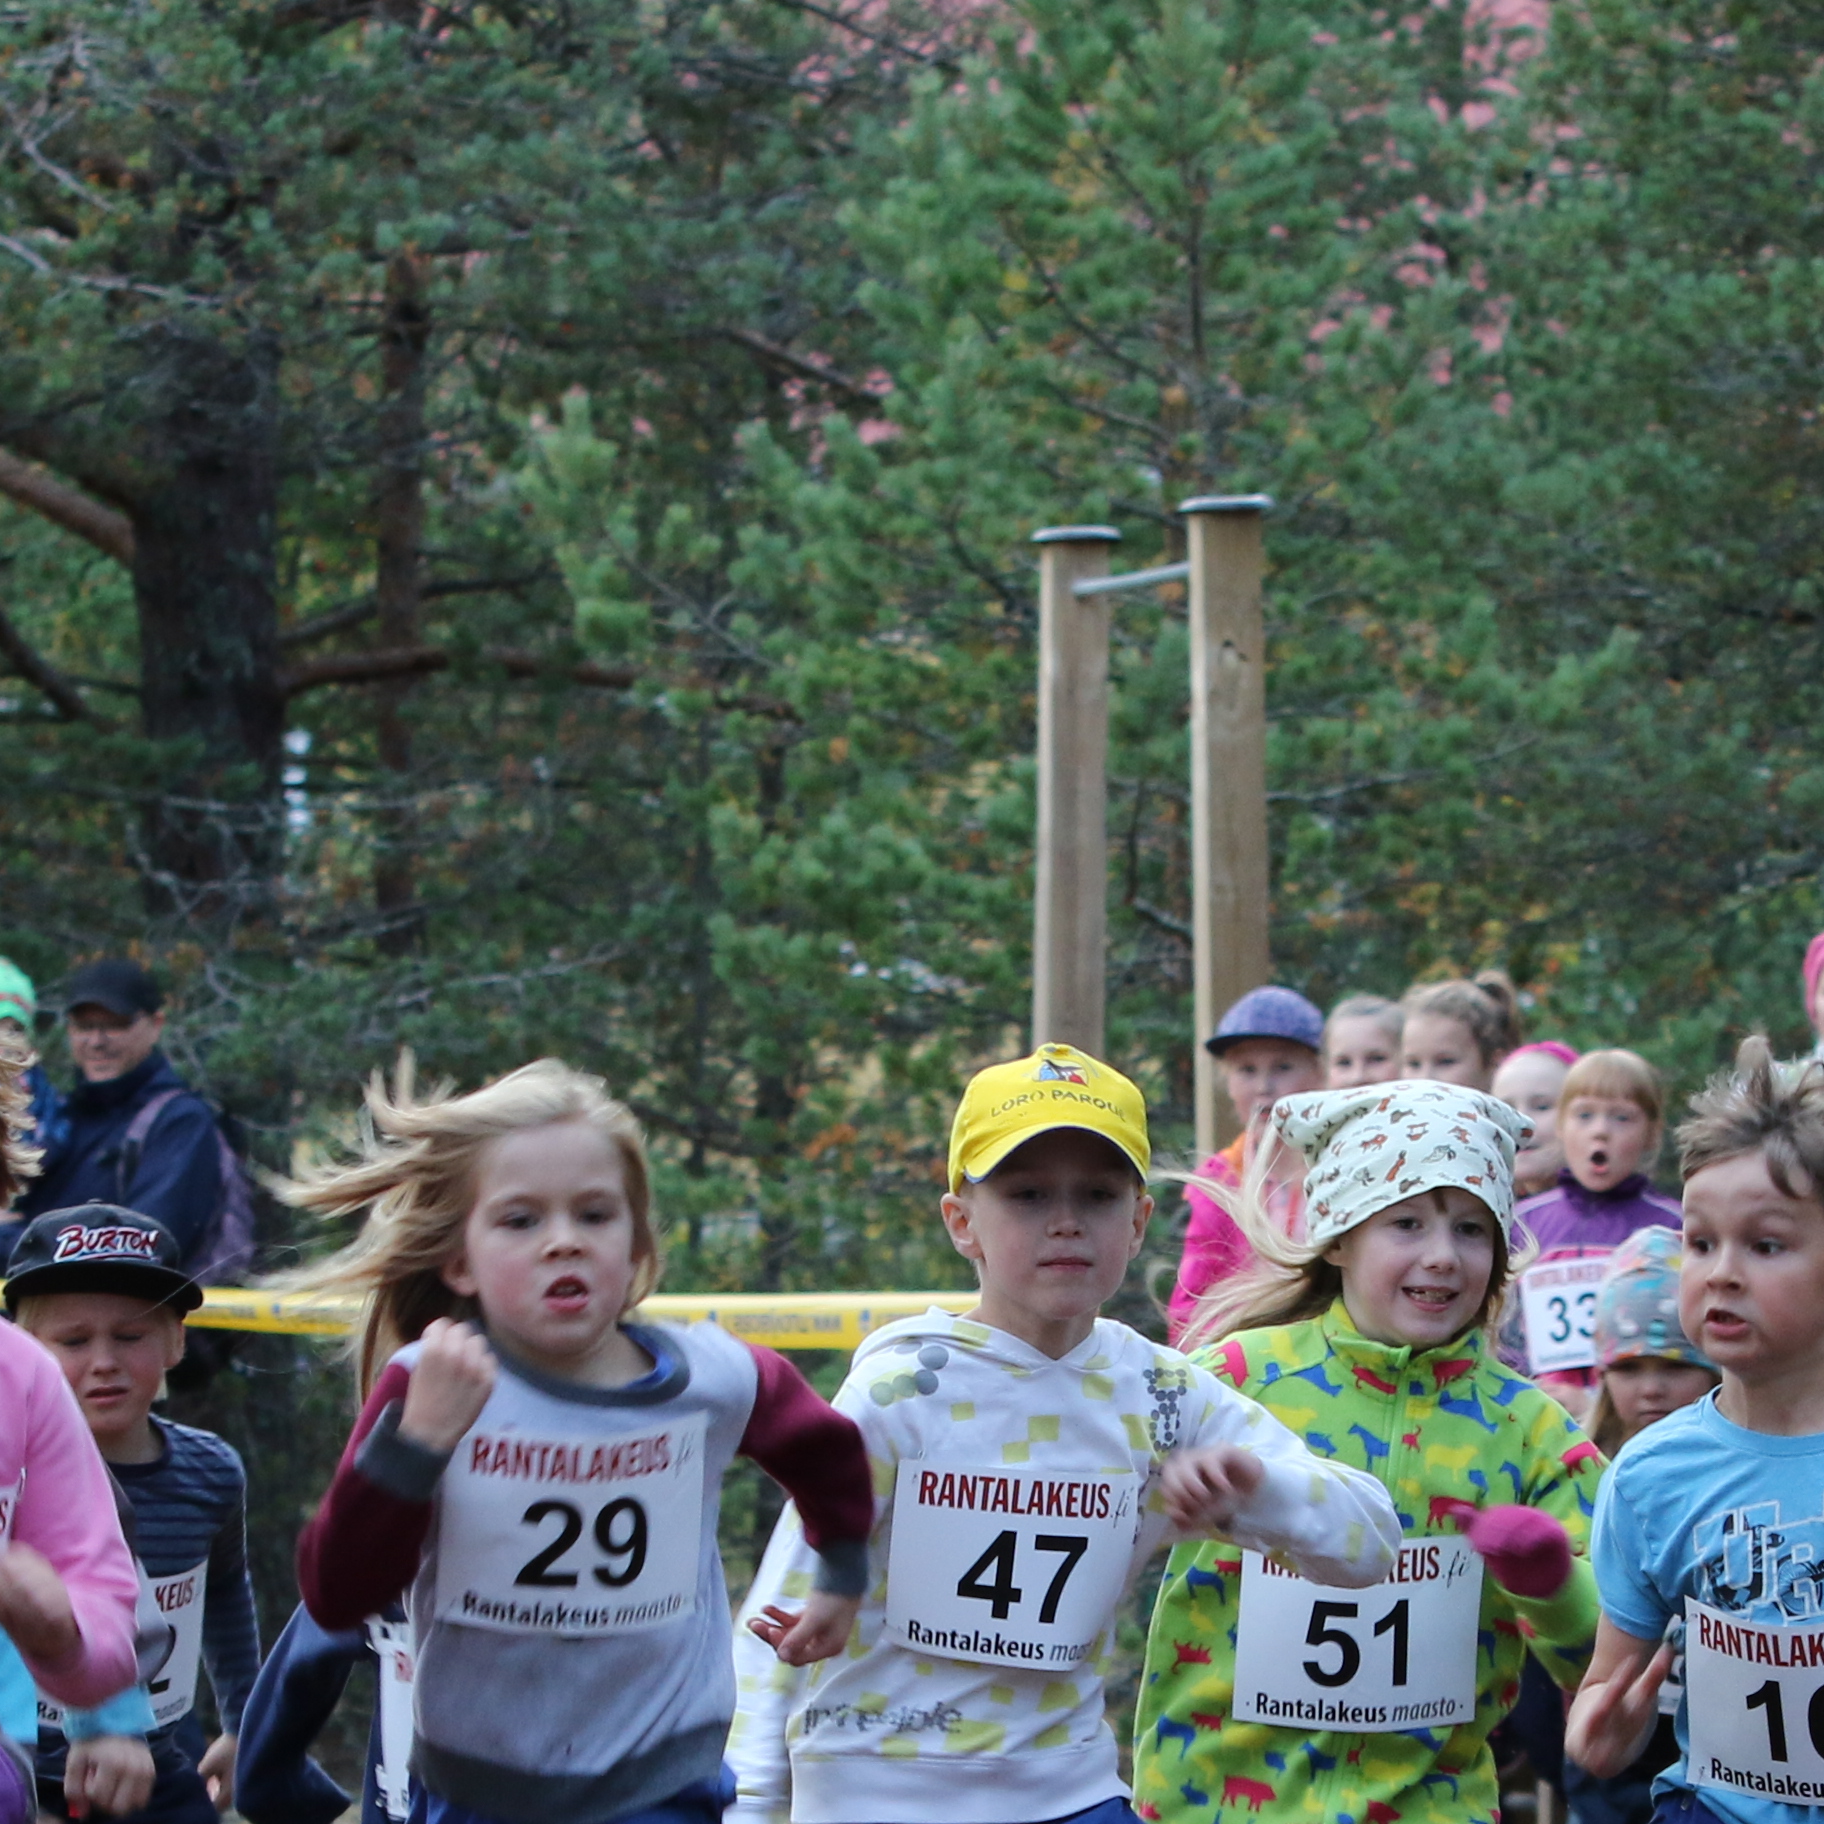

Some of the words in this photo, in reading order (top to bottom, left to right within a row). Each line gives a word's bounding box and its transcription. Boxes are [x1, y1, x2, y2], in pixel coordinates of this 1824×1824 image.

[991, 1090, 1044, 1117] LORO
[54, 1225, 160, 1262] BURTON
[513, 1496, 648, 1588] 29
[957, 1530, 1089, 1624] 47
[462, 1590, 609, 1628] Rantalakeus
[614, 1594, 682, 1624] maasto
[908, 1619, 1045, 1660] Rantalakeus
[1302, 1599, 1409, 1688] 51
[1256, 1692, 1387, 1723] Rantalakeus
[1391, 1697, 1456, 1723] maasto
